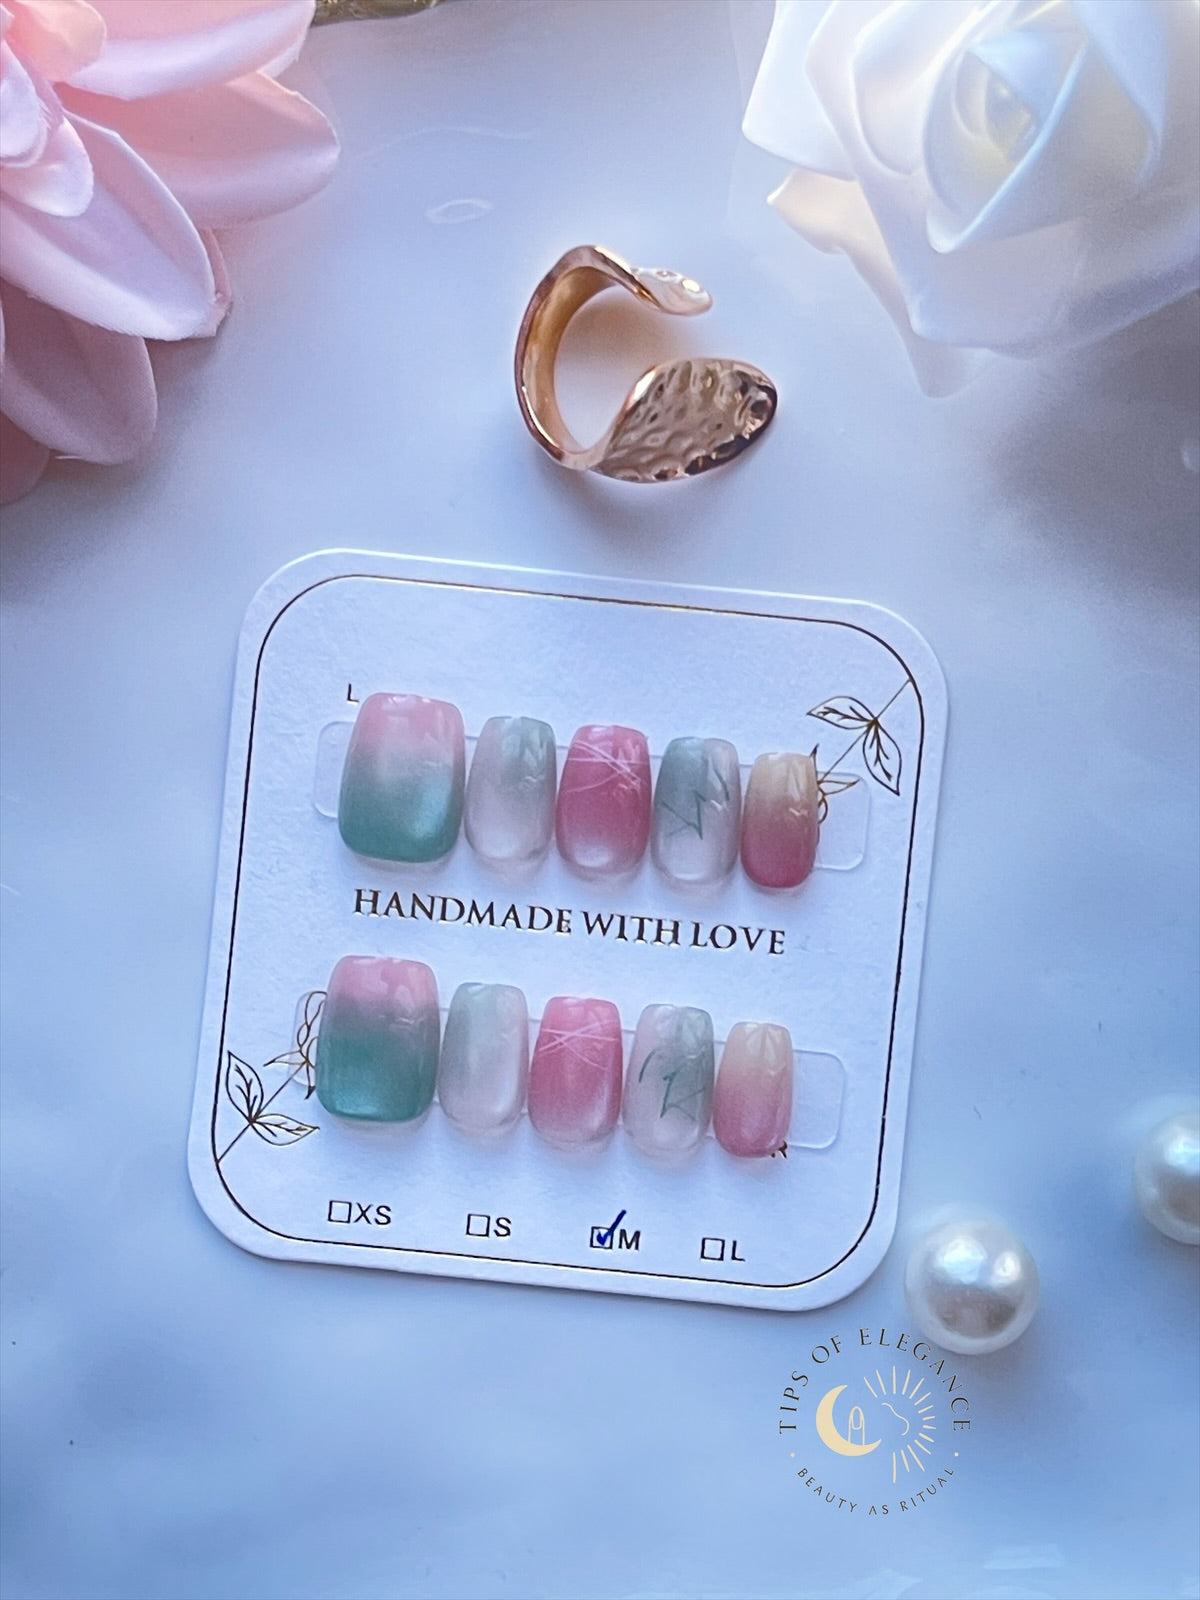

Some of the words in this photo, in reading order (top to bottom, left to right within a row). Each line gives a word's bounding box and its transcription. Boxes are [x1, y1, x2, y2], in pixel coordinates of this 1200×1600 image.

[347, 683, 360, 703] L
[353, 888, 572, 935] HANDMADE
[582, 910, 680, 947] WITH
[691, 921, 786, 956] LOVE
[353, 1204, 392, 1226] XS
[493, 1217, 512, 1238] S
[617, 1230, 641, 1252] M
[731, 1240, 746, 1262] L
